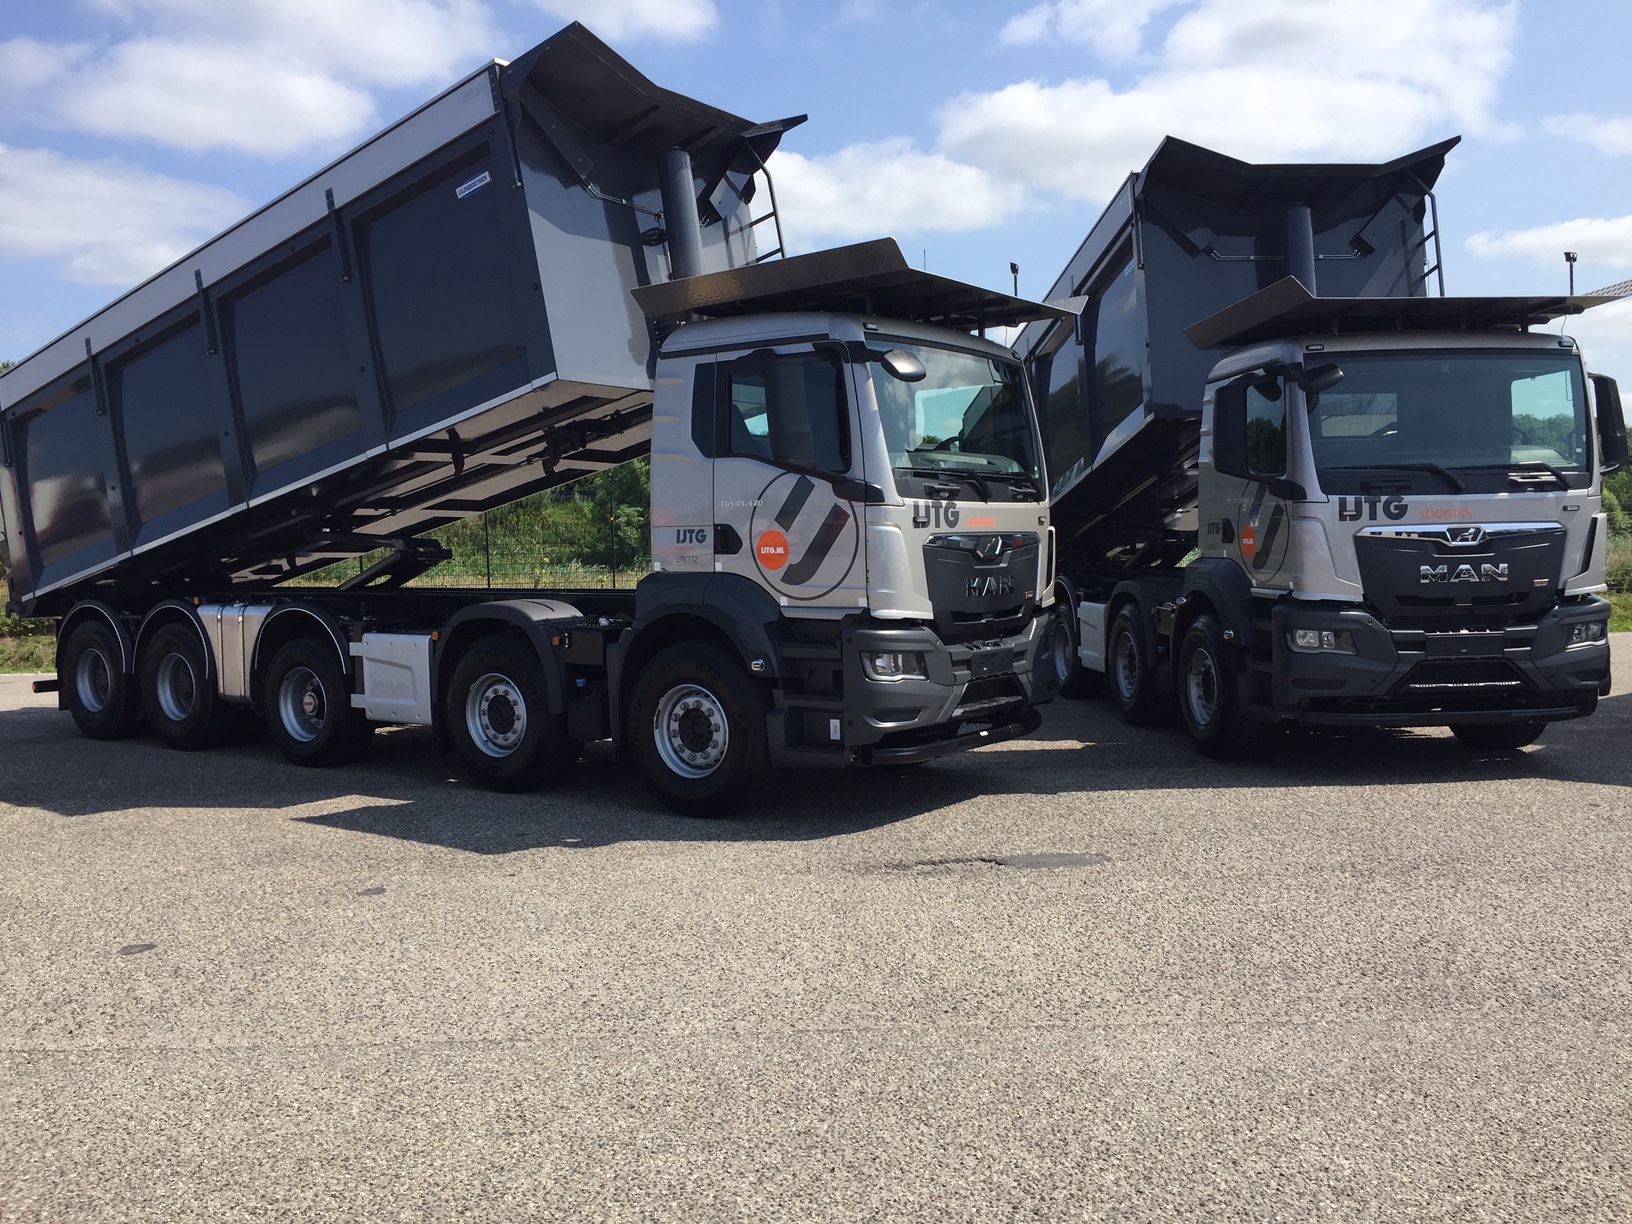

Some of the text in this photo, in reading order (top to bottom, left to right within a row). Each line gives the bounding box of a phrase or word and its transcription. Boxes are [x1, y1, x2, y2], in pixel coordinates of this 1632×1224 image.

[913, 500, 960, 529] IJTG
[1338, 495, 1472, 522] IJTG LOGISTICS
[676, 529, 707, 544] IJTG
[1420, 563, 1508, 584] MAN
[965, 575, 1015, 598] MAN
